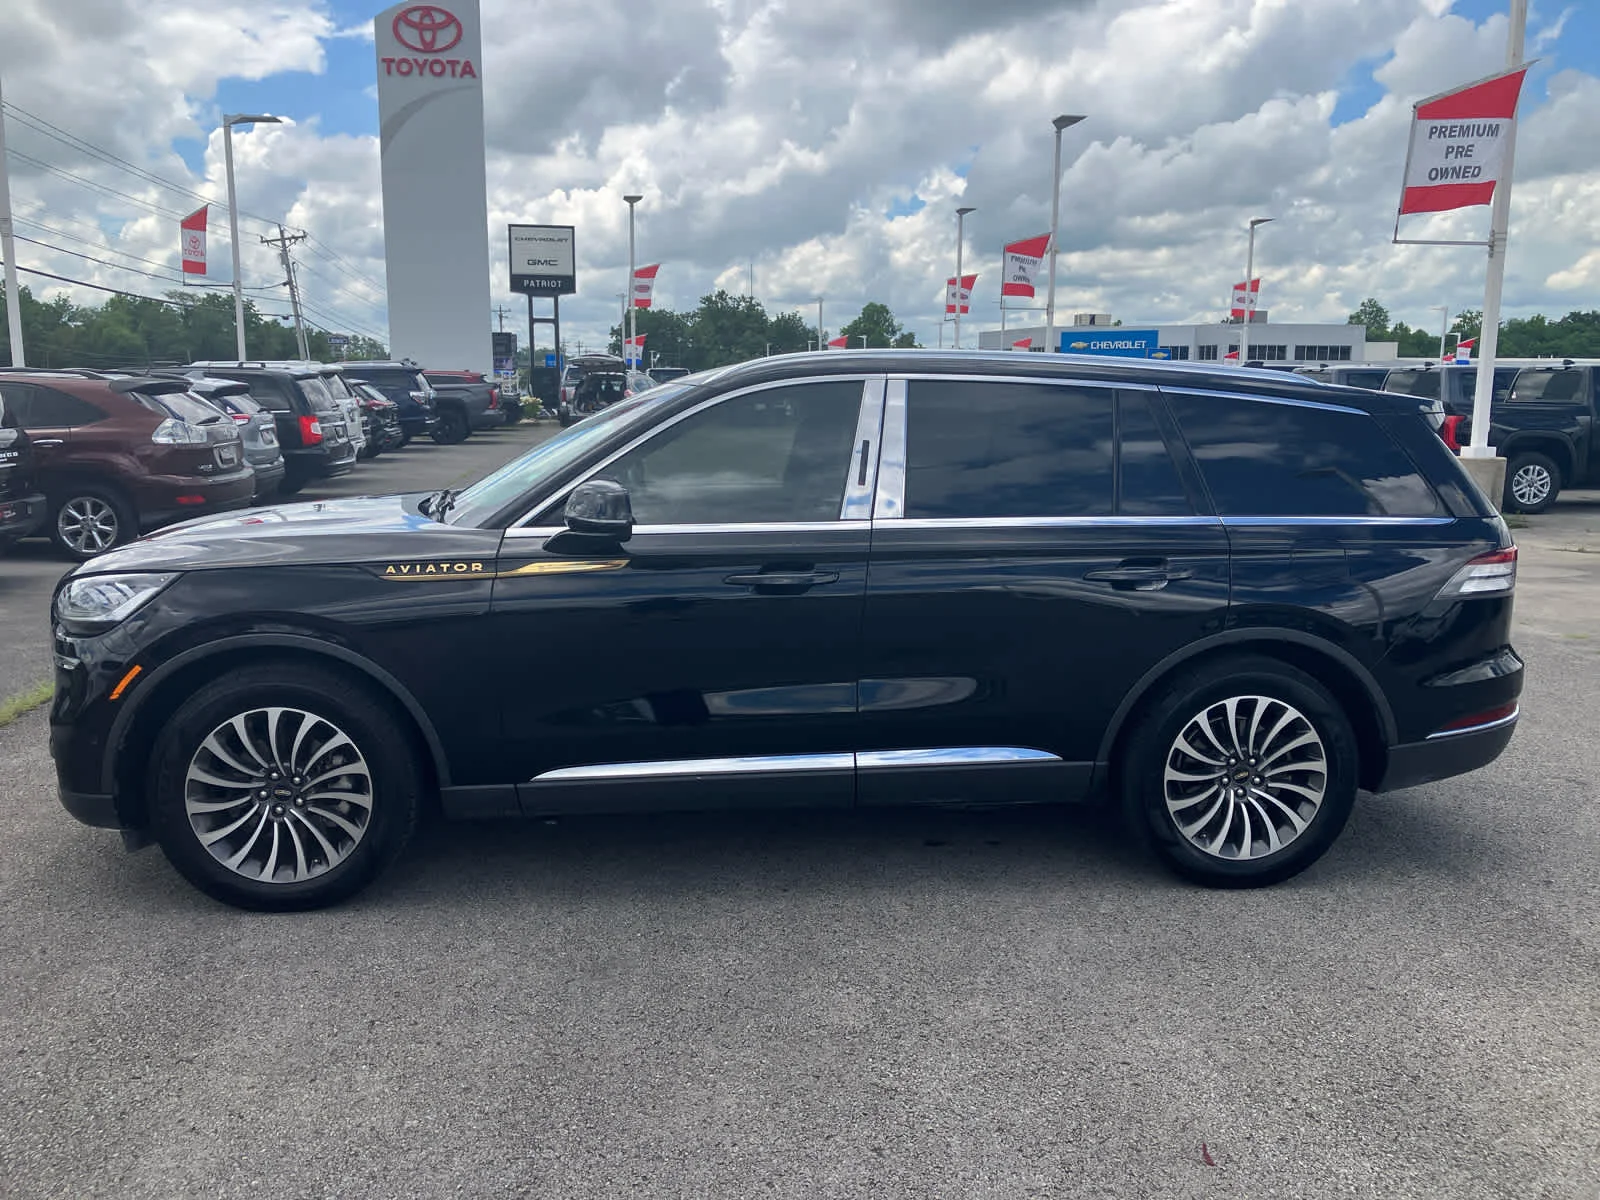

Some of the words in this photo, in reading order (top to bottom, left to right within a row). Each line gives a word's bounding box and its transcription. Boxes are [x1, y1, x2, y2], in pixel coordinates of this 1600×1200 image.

[381, 58, 477, 78] TOYOTA
[1428, 124, 1500, 139] PREMIUM
[1444, 144, 1475, 159] PRE
[1428, 165, 1482, 181] OWNED
[523, 279, 562, 288] PATRIOT
[1090, 340, 1147, 350] CHEVROLET
[385, 562, 485, 574] AVIATOR
